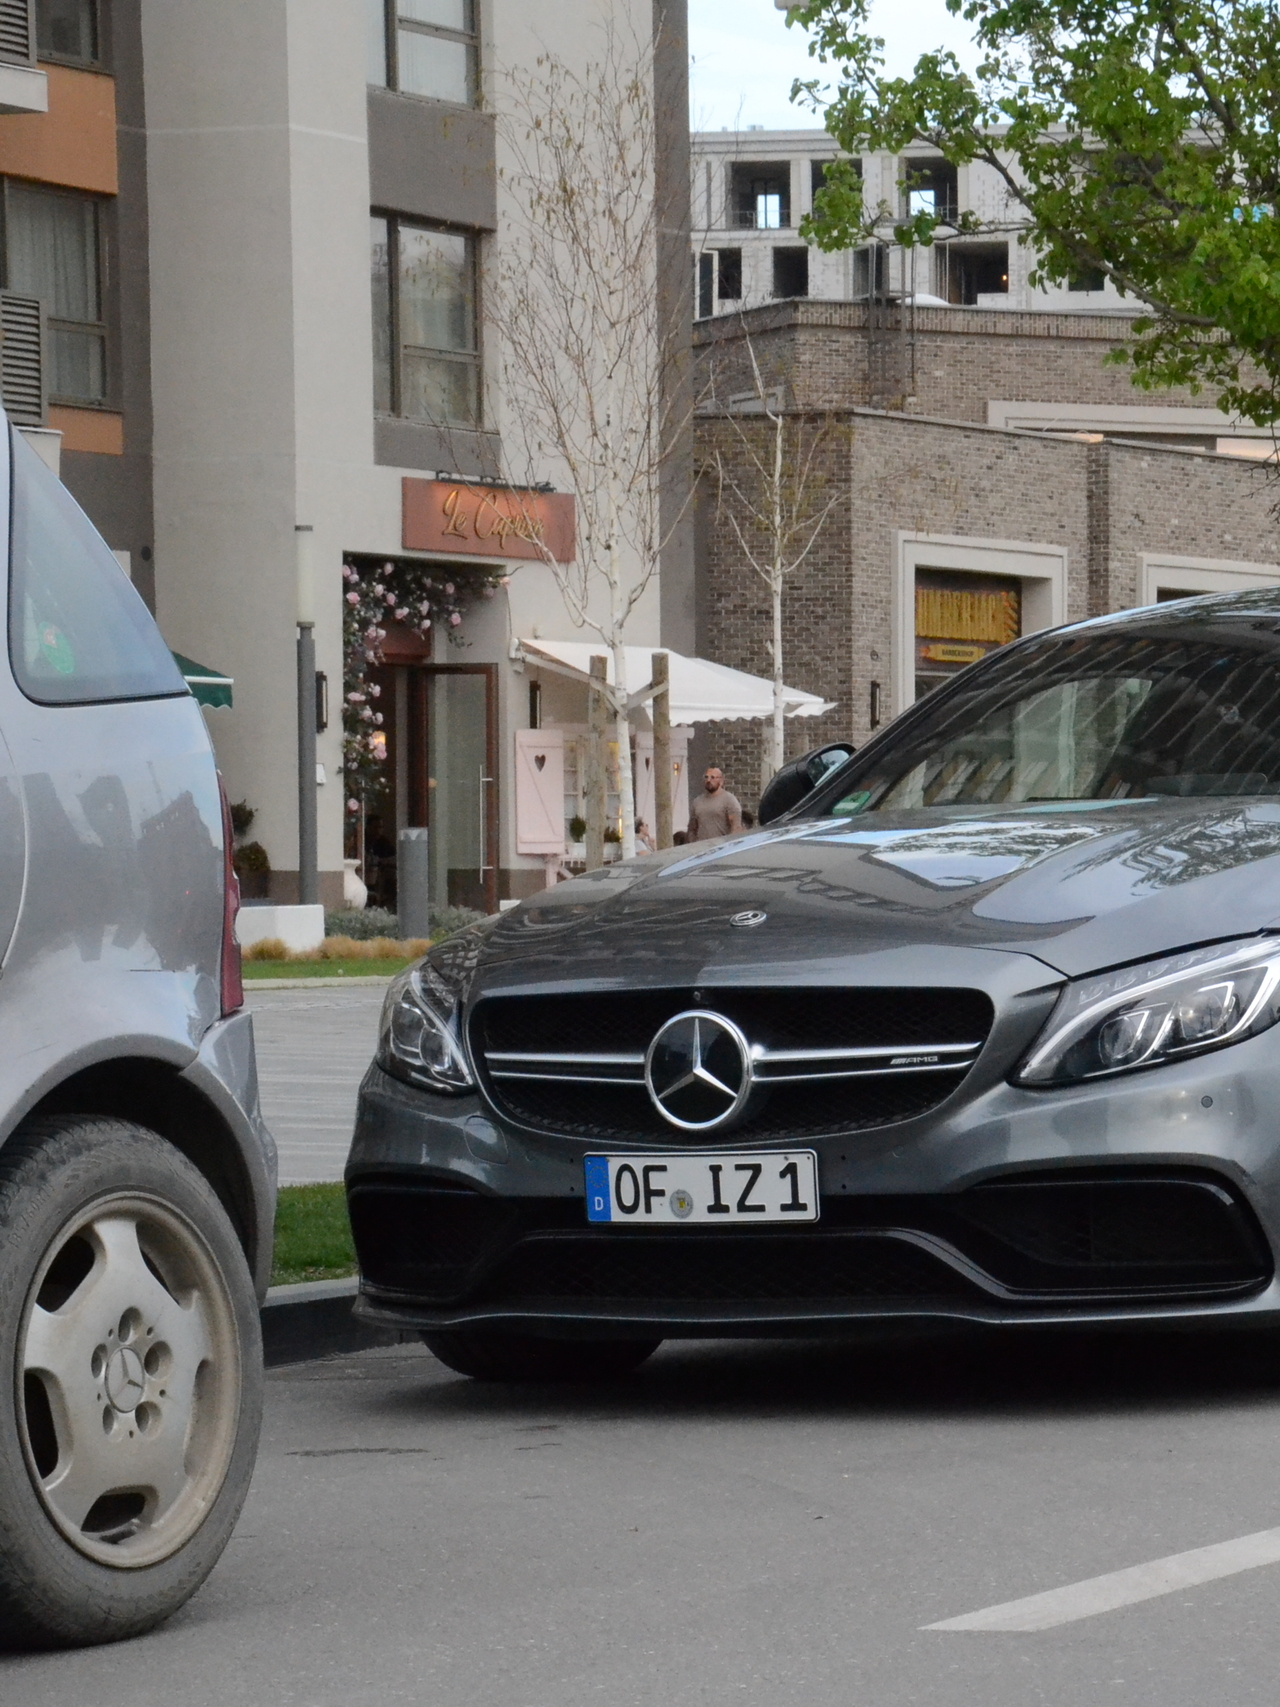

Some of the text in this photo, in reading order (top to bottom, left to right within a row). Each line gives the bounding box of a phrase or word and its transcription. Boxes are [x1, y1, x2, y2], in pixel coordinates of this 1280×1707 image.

[442, 490, 468, 540] Le
[905, 1055, 939, 1064] AMG
[594, 1196, 604, 1211] D
[615, 1163, 668, 1215] OF
[706, 1163, 767, 1214] IZ
[779, 1162, 808, 1212] 1
